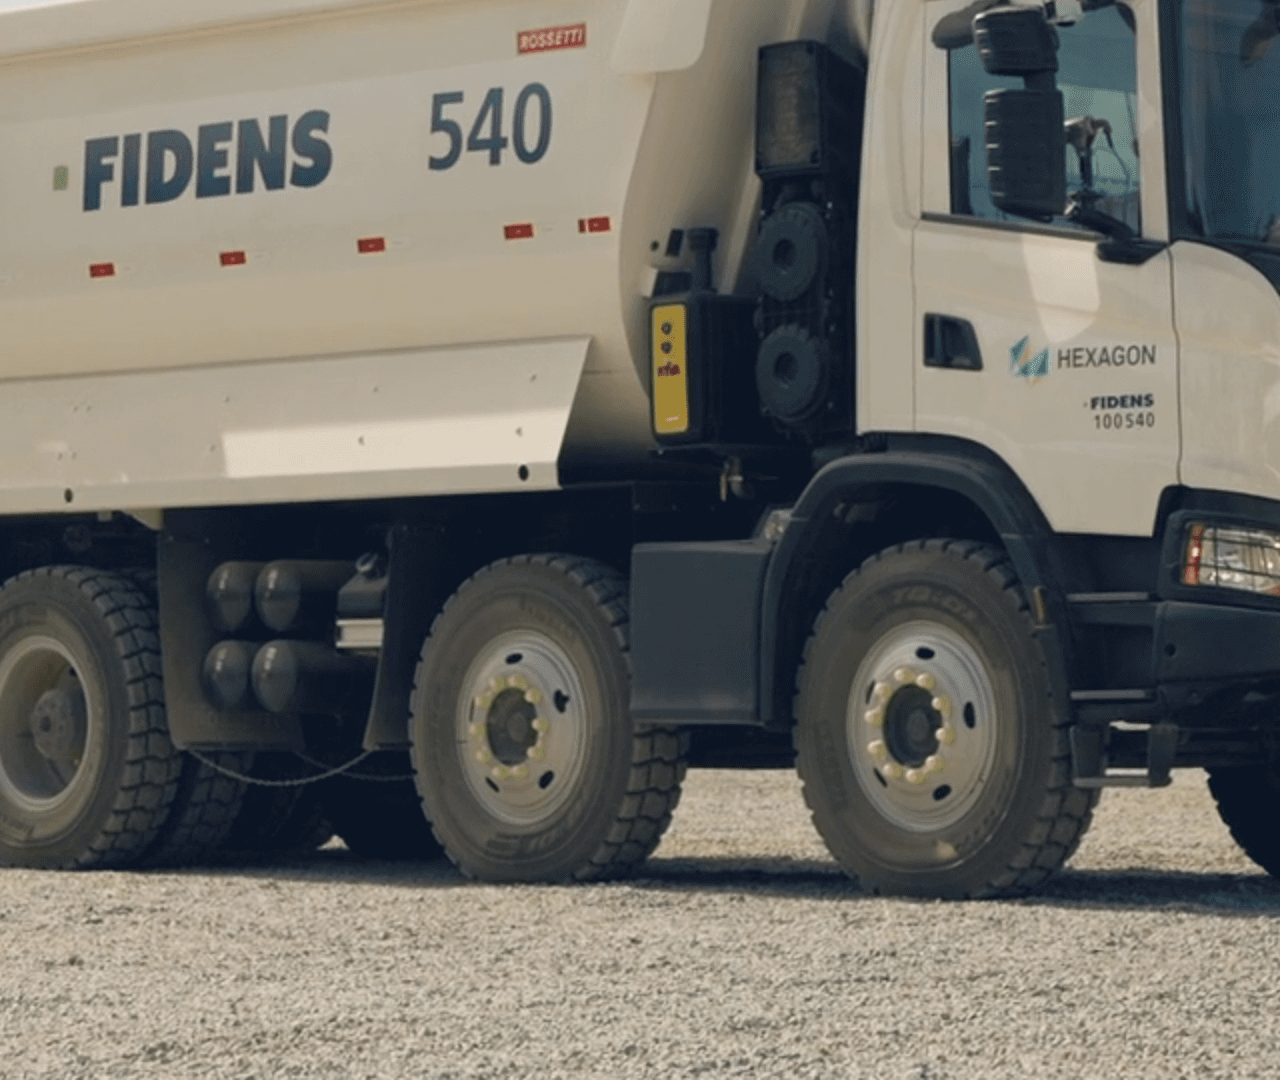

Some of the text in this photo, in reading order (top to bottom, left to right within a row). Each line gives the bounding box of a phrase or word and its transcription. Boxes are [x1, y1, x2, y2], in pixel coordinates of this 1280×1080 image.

[520, 28, 583, 50] ROSSETTI
[428, 81, 553, 171] 540
[82, 109, 334, 212] FIDENS
[1057, 345, 1156, 369] HEXAGON
[1091, 394, 1154, 410] FIDENS
